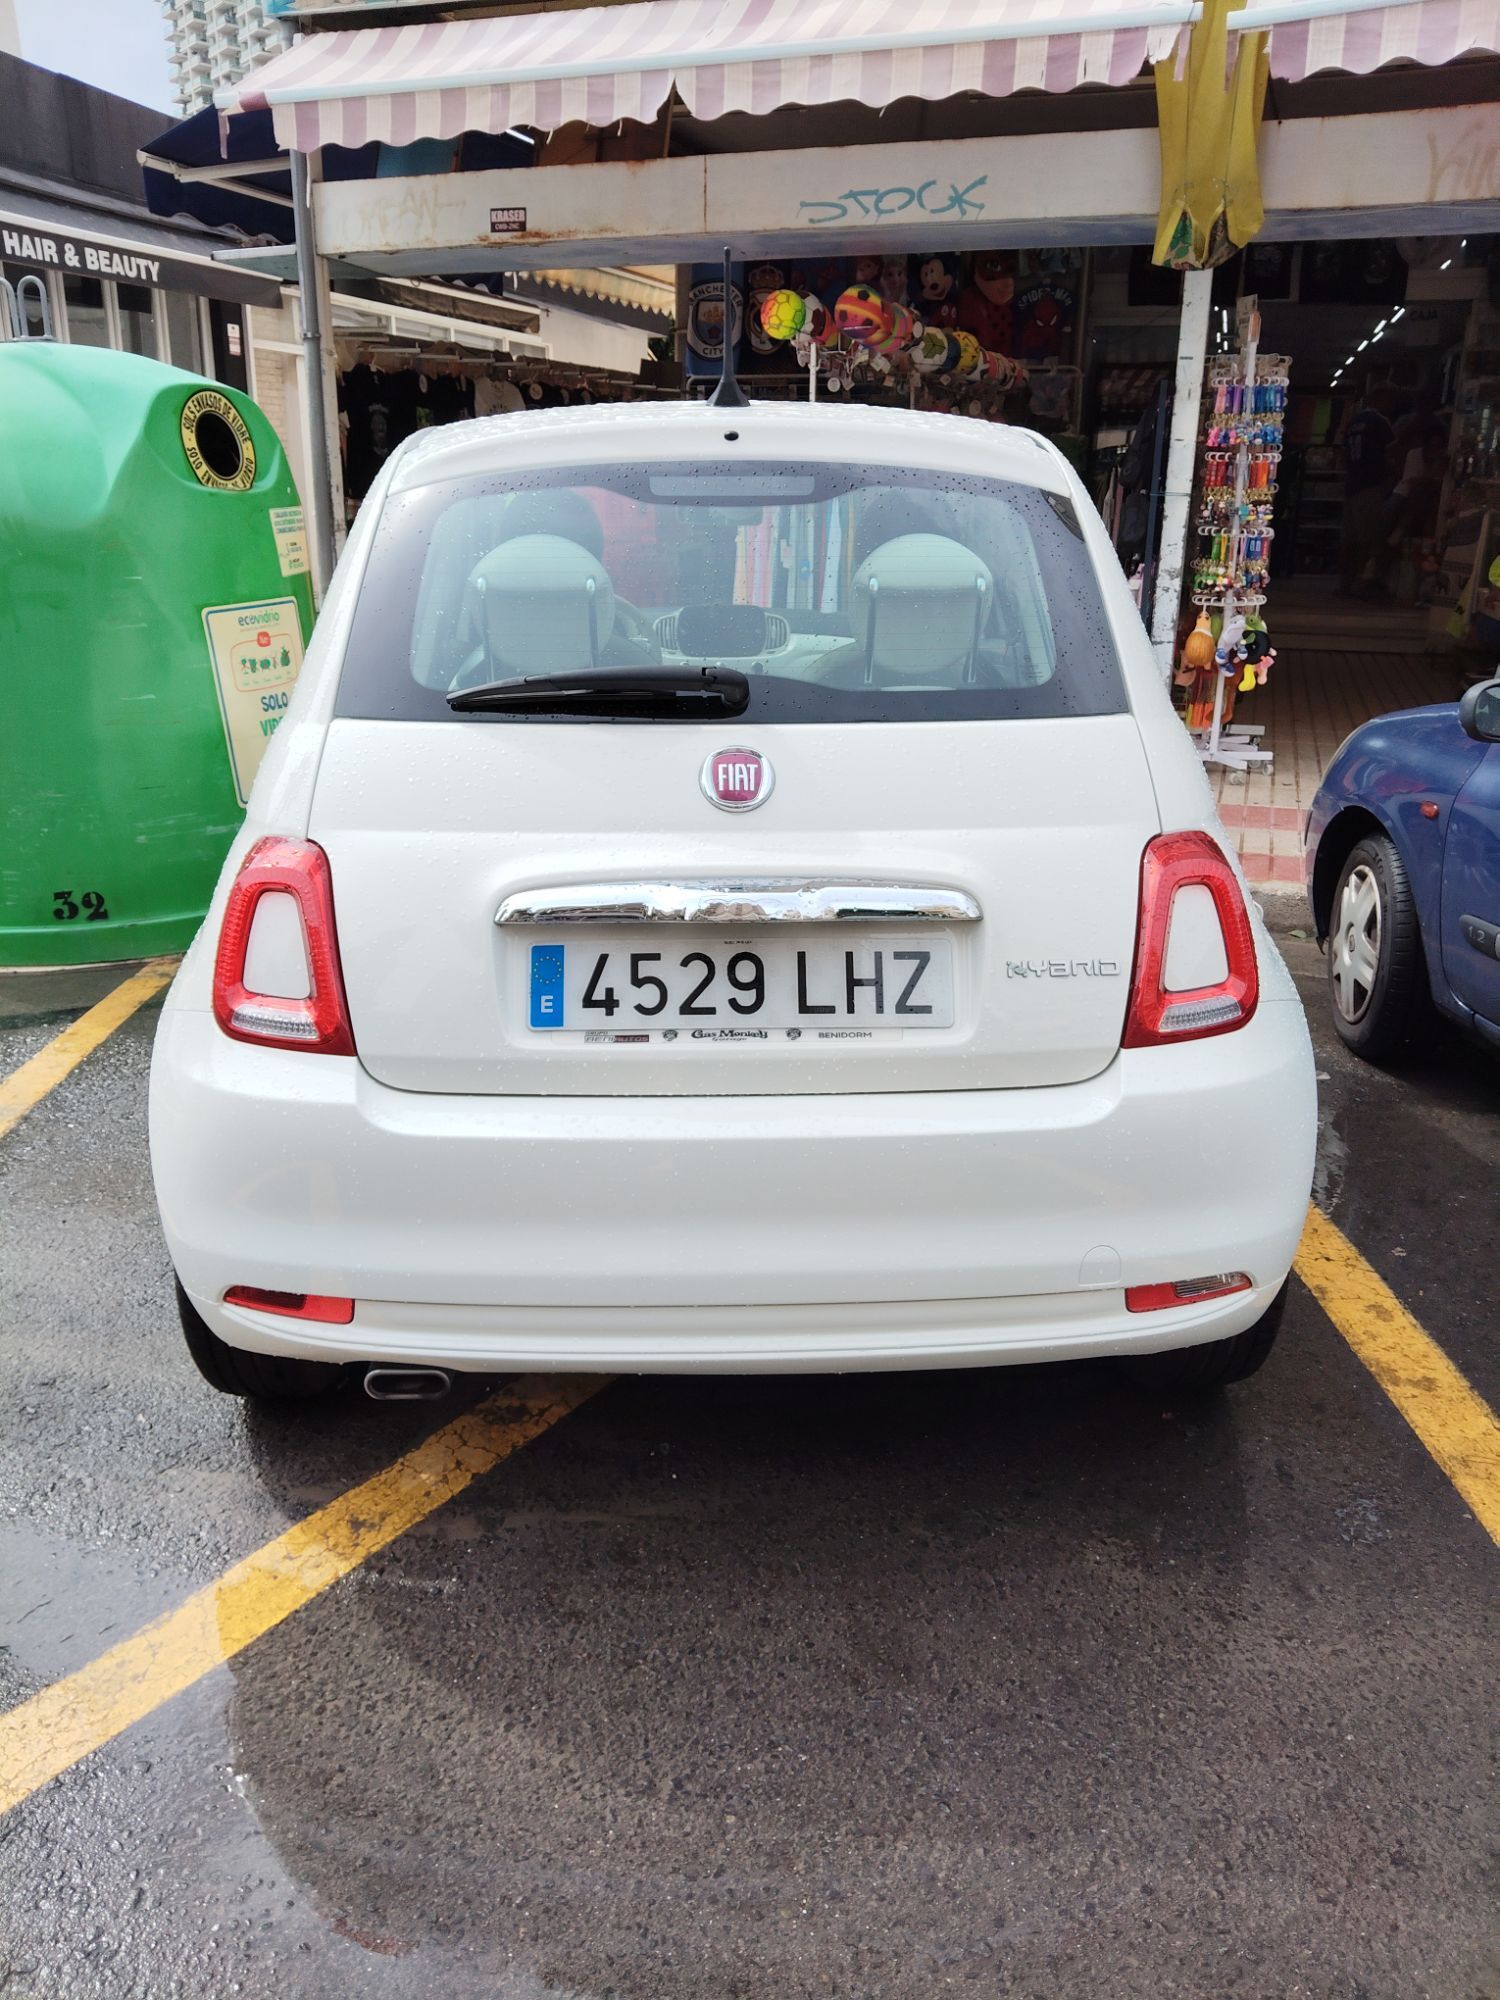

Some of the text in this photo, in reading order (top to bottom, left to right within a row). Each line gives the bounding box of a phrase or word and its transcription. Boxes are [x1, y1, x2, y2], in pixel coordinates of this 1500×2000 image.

[796, 174, 988, 224] STOCK
[491, 210, 525, 222] KRASER
[2, 230, 160, 282] HAIR & BEAUTY
[688, 283, 742, 307] MANCHETER
[183, 393, 250, 444] SOLS ENVASOS DE VIDRE
[187, 447, 203, 470] SOLO
[238, 610, 280, 626] ecovidrio
[261, 692, 289, 712] SOLO
[718, 763, 759, 791] FIAT
[53, 890, 109, 921] 32
[581, 951, 933, 1016] 4529 LHZ
[540, 995, 553, 1013] E
[691, 1029, 769, 1040] Gas Monkey
[818, 1031, 873, 1039] BENIDORM
